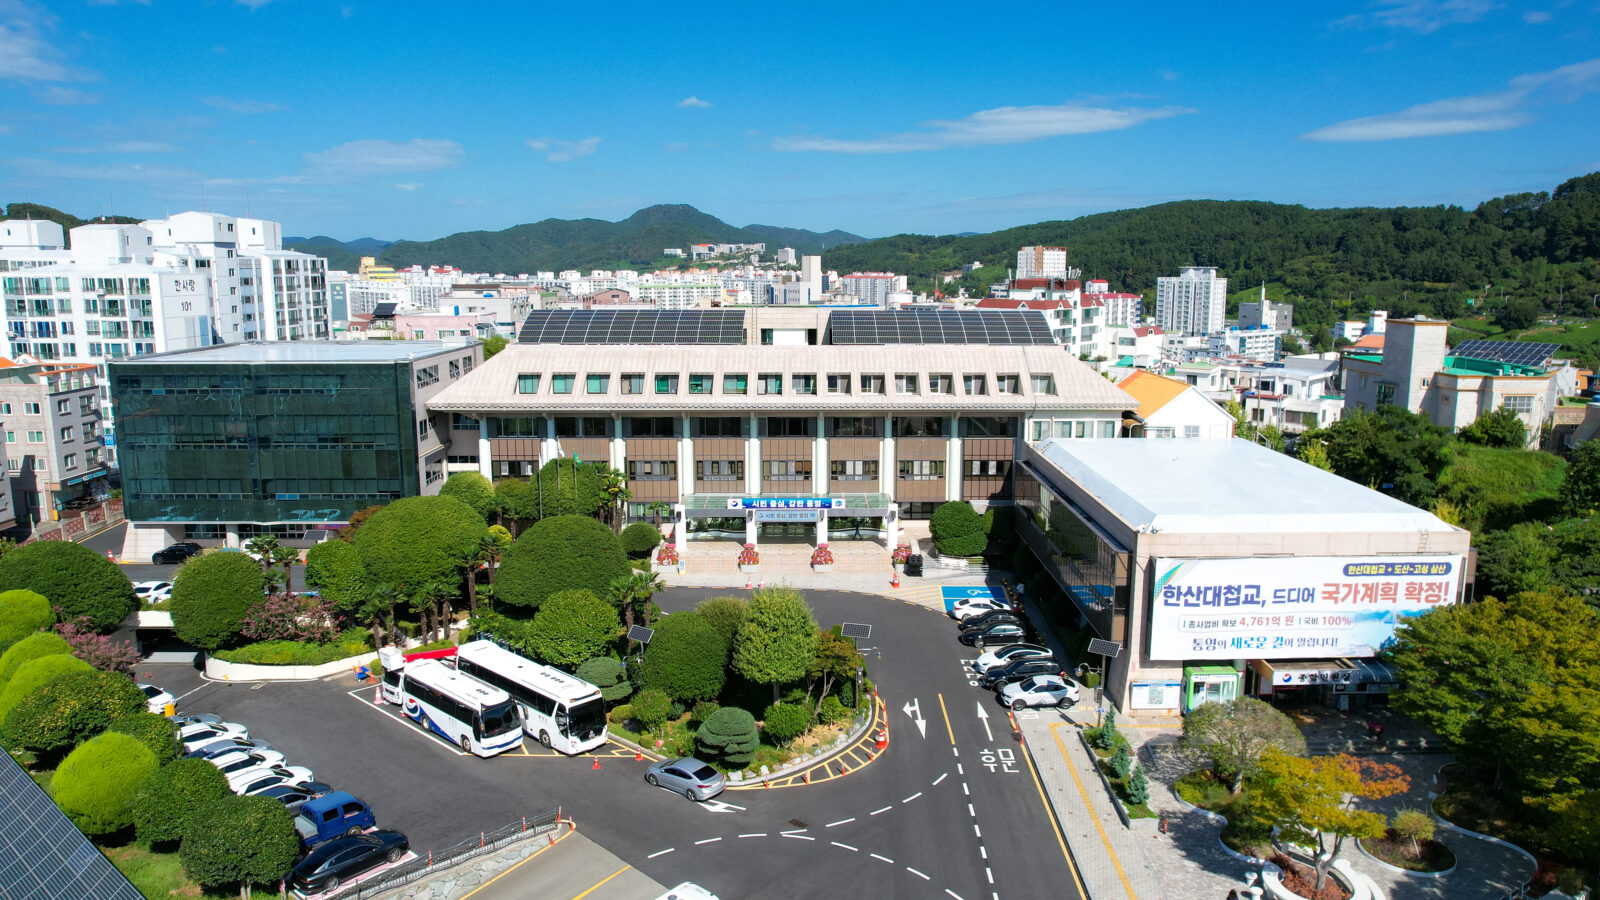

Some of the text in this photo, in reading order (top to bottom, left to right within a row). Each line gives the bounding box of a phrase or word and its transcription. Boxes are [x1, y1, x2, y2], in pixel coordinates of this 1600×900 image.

[174, 279, 195, 291] 한사랑
[181, 301, 192, 312] 101
[752, 500, 767, 508] 시민
[1348, 565, 1386, 575] 한산대첩교
[1430, 564, 1446, 575] 삼산
[1163, 581, 1450, 608] 한산대첩교, 드디어 국가계획 확정!
[1188, 615, 1352, 629] 총사업비 확보 4,761억 원 국비 100%
[1192, 636, 1338, 651] 통영의 새로운 길이 열립니다!
[1298, 674, 1350, 685] 종합민원실
[979, 749, 1020, 773] 후문
